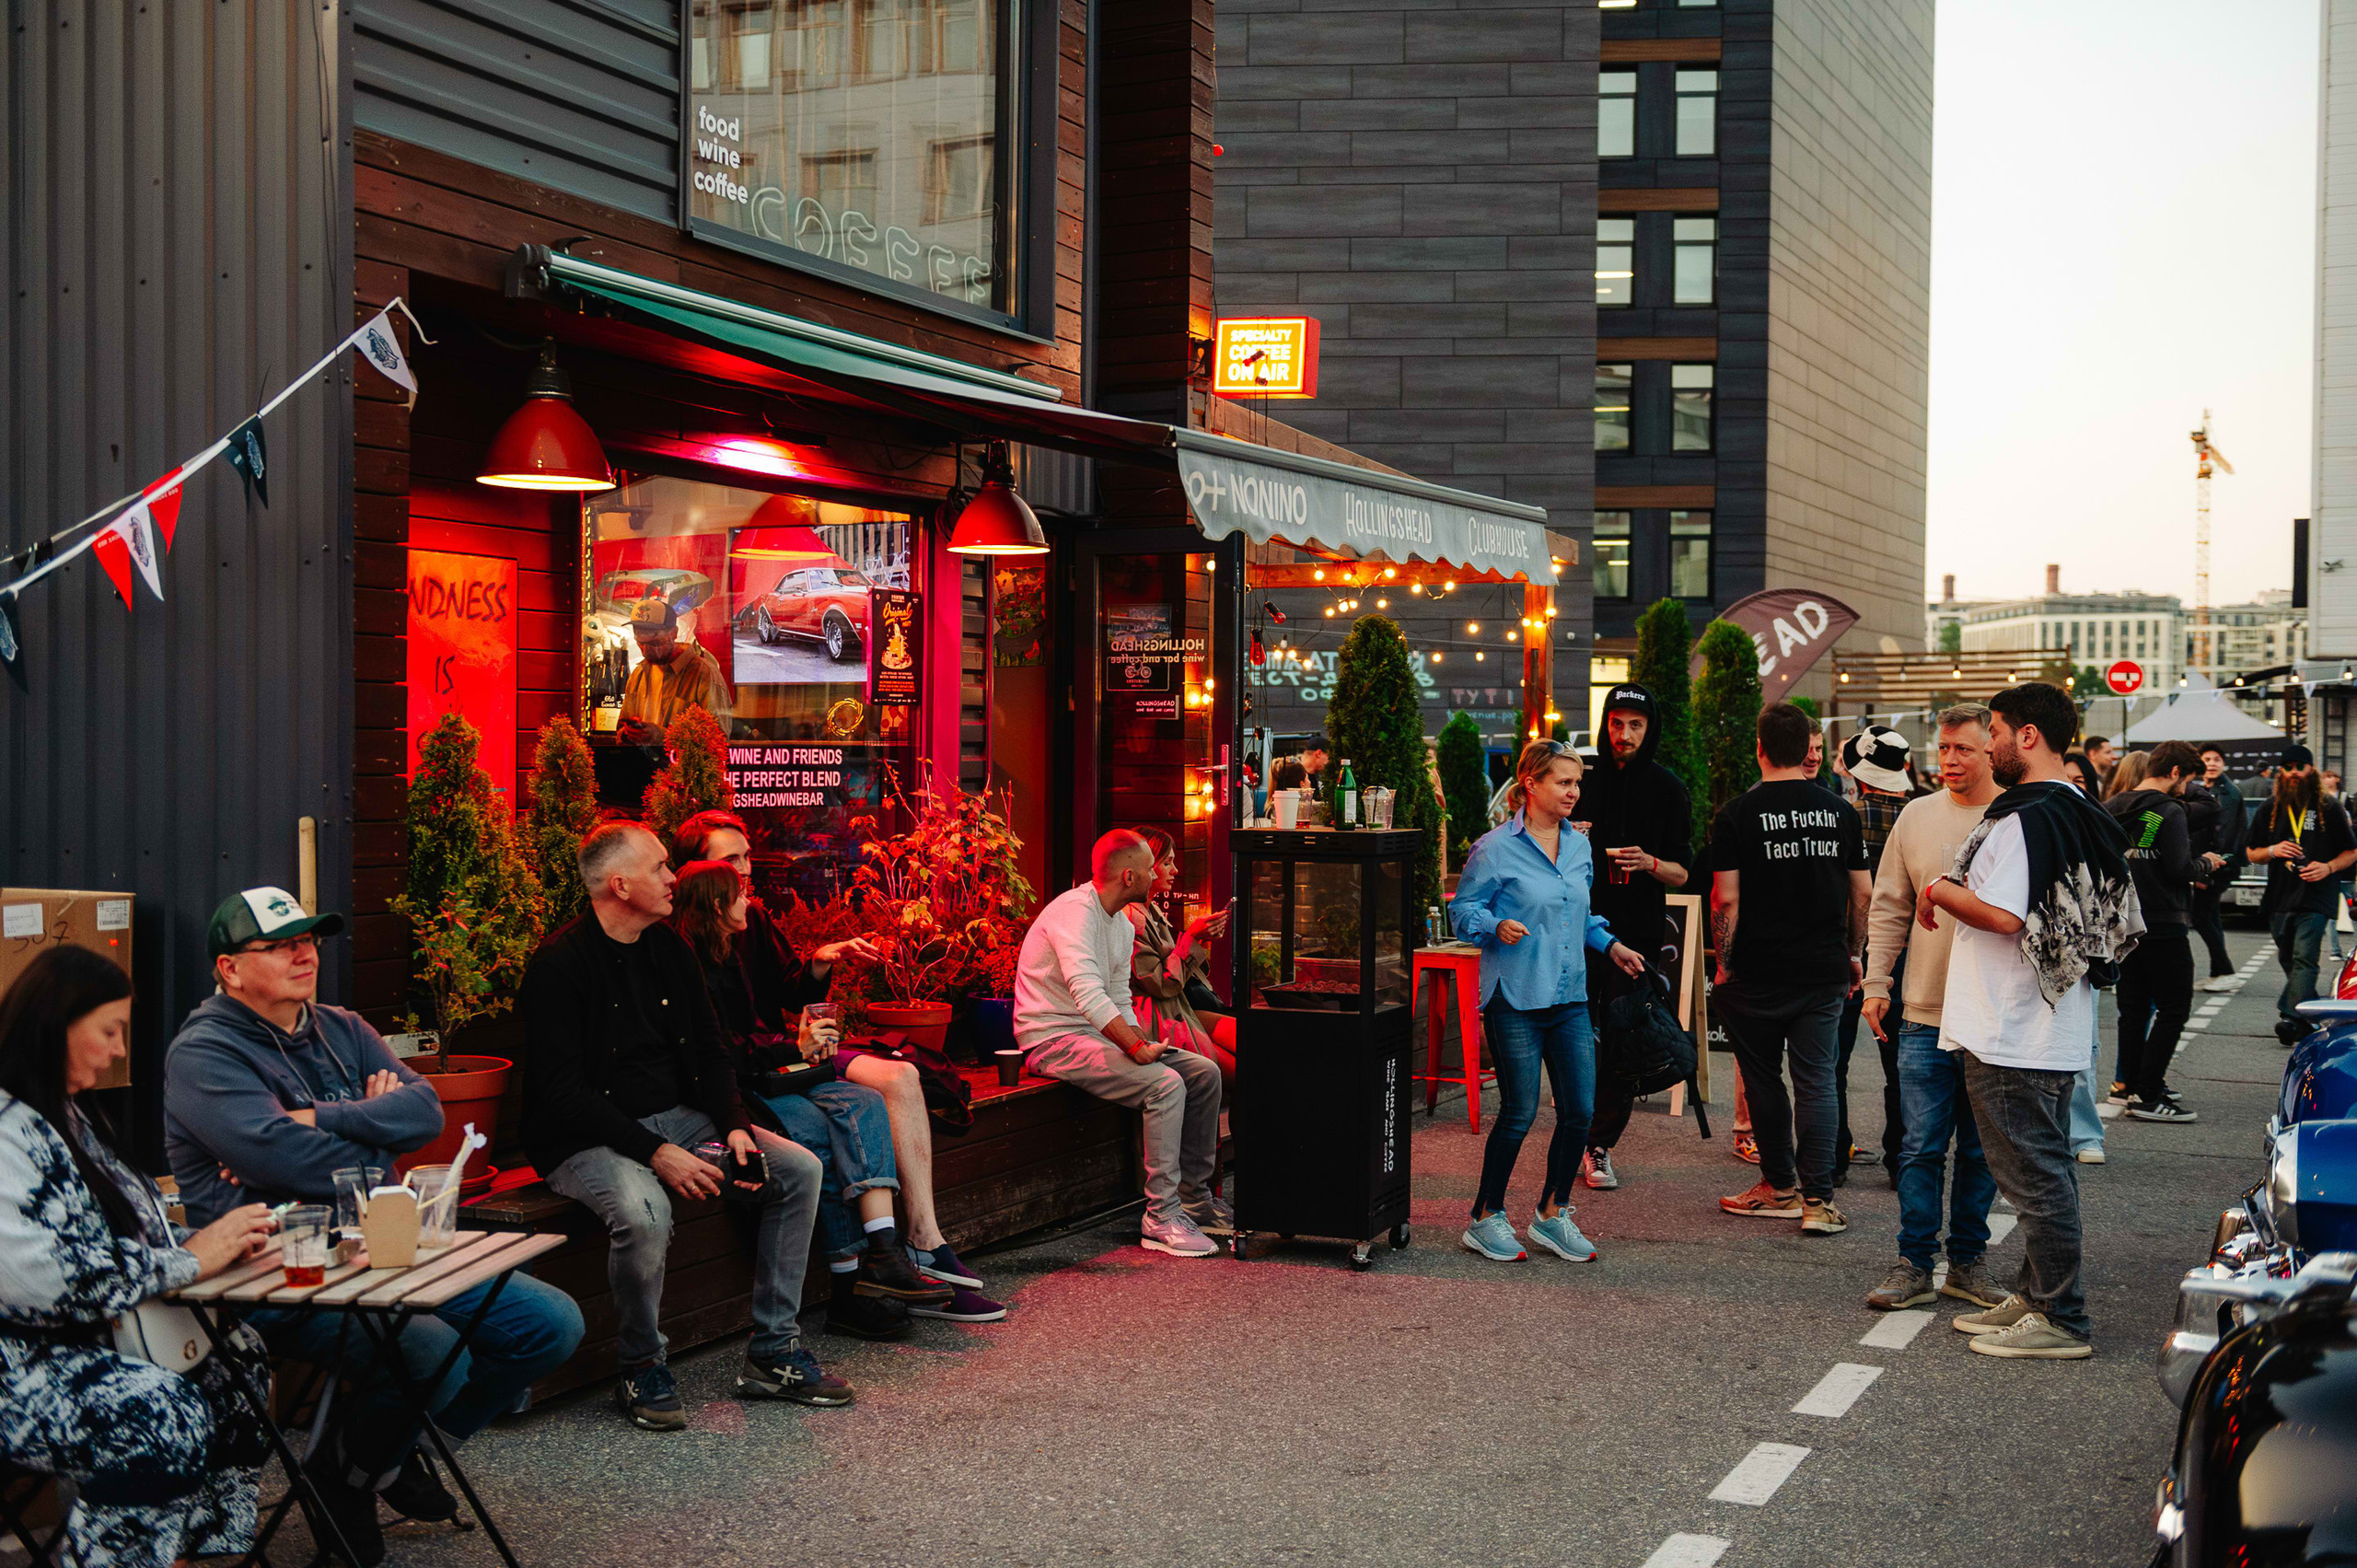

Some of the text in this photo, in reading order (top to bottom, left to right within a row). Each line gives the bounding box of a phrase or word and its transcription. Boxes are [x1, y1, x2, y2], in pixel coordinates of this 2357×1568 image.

[699, 104, 739, 142] food
[697, 137, 741, 169] wine
[694, 168, 749, 205] coffee
[1230, 329, 1292, 343] SPECIALTY
[1229, 343, 1292, 361] COFFEE
[1228, 363, 1290, 381] ON AIR
[1230, 472, 1307, 526] NONINO
[1344, 492, 1433, 545] HOLLINGSHEAD
[1468, 516, 1530, 560] CLUBHOUSE
[1751, 600, 1829, 677] EAD
[1615, 691, 1645, 702] Packers
[728, 748, 842, 765] WINE AND FRIENDS
[723, 771, 842, 788] HE PERFECT BLEND
[1759, 808, 1840, 831] The Fuckin'
[1763, 841, 1800, 860] Taco
[1802, 836, 1840, 857] Truck
